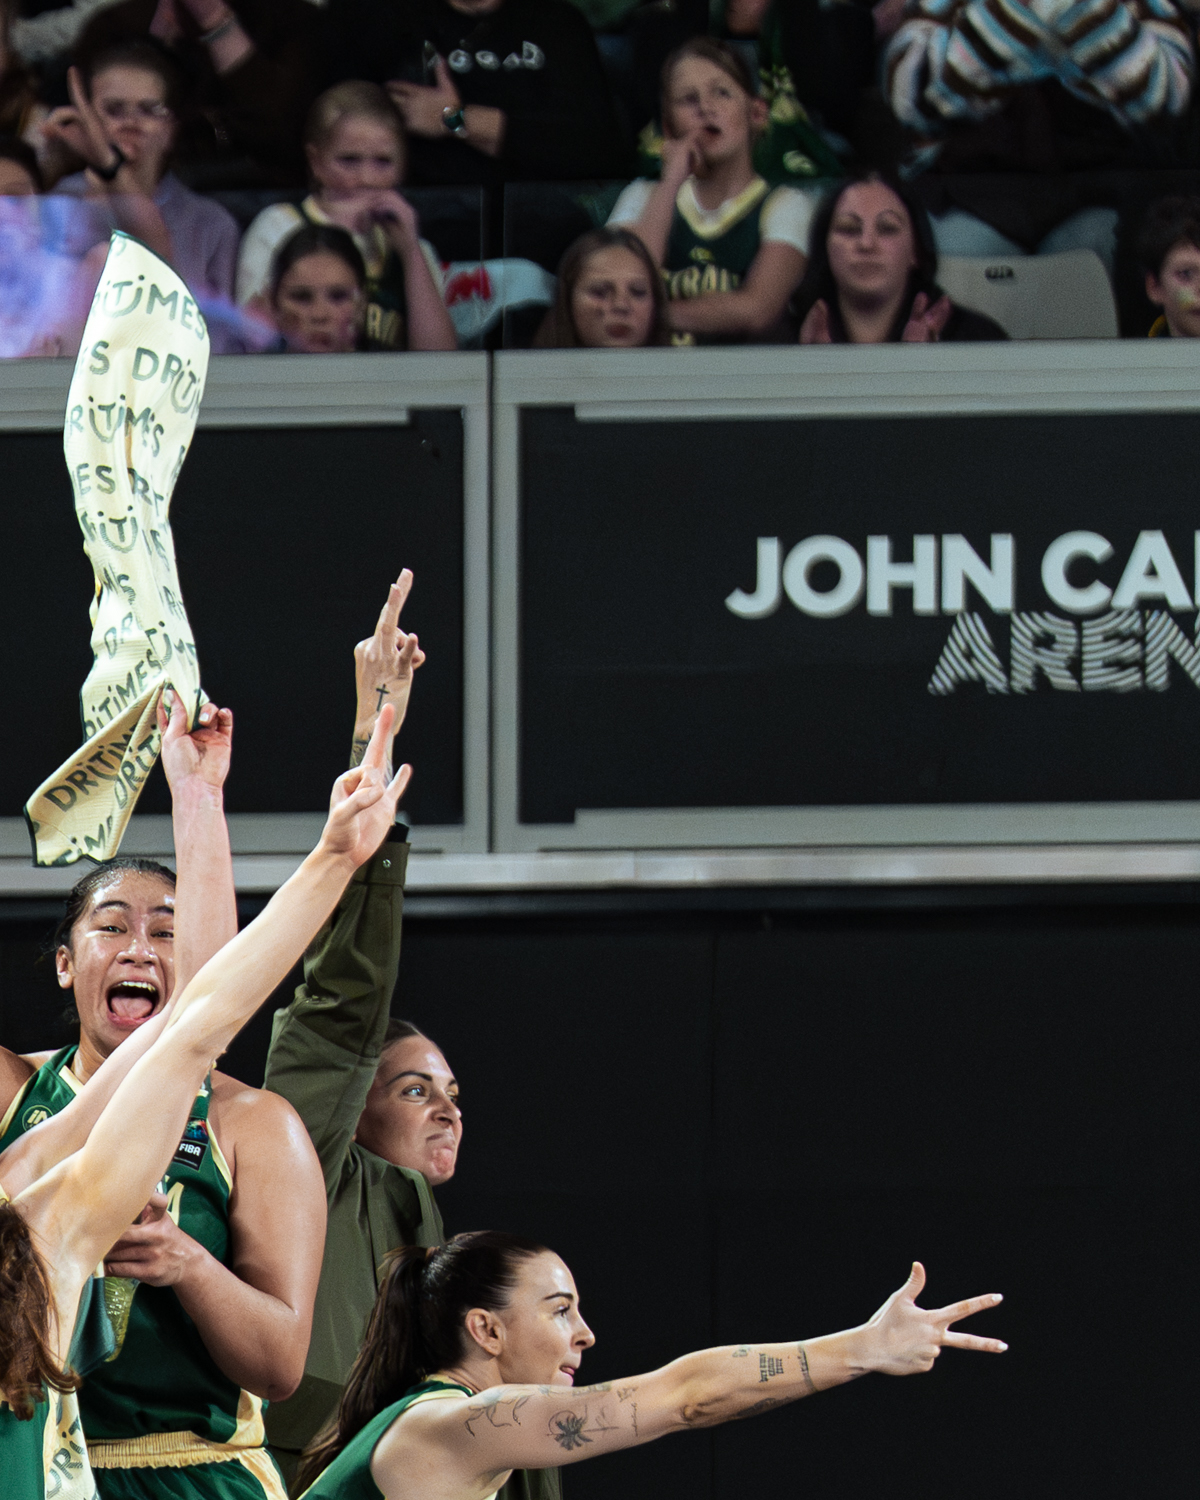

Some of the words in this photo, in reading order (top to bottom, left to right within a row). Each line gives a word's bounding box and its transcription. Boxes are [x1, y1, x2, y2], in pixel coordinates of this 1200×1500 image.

[724, 532, 1014, 620] JOHN
[1040, 529, 1200, 616] CA
[178, 1142, 202, 1157] FIBA
